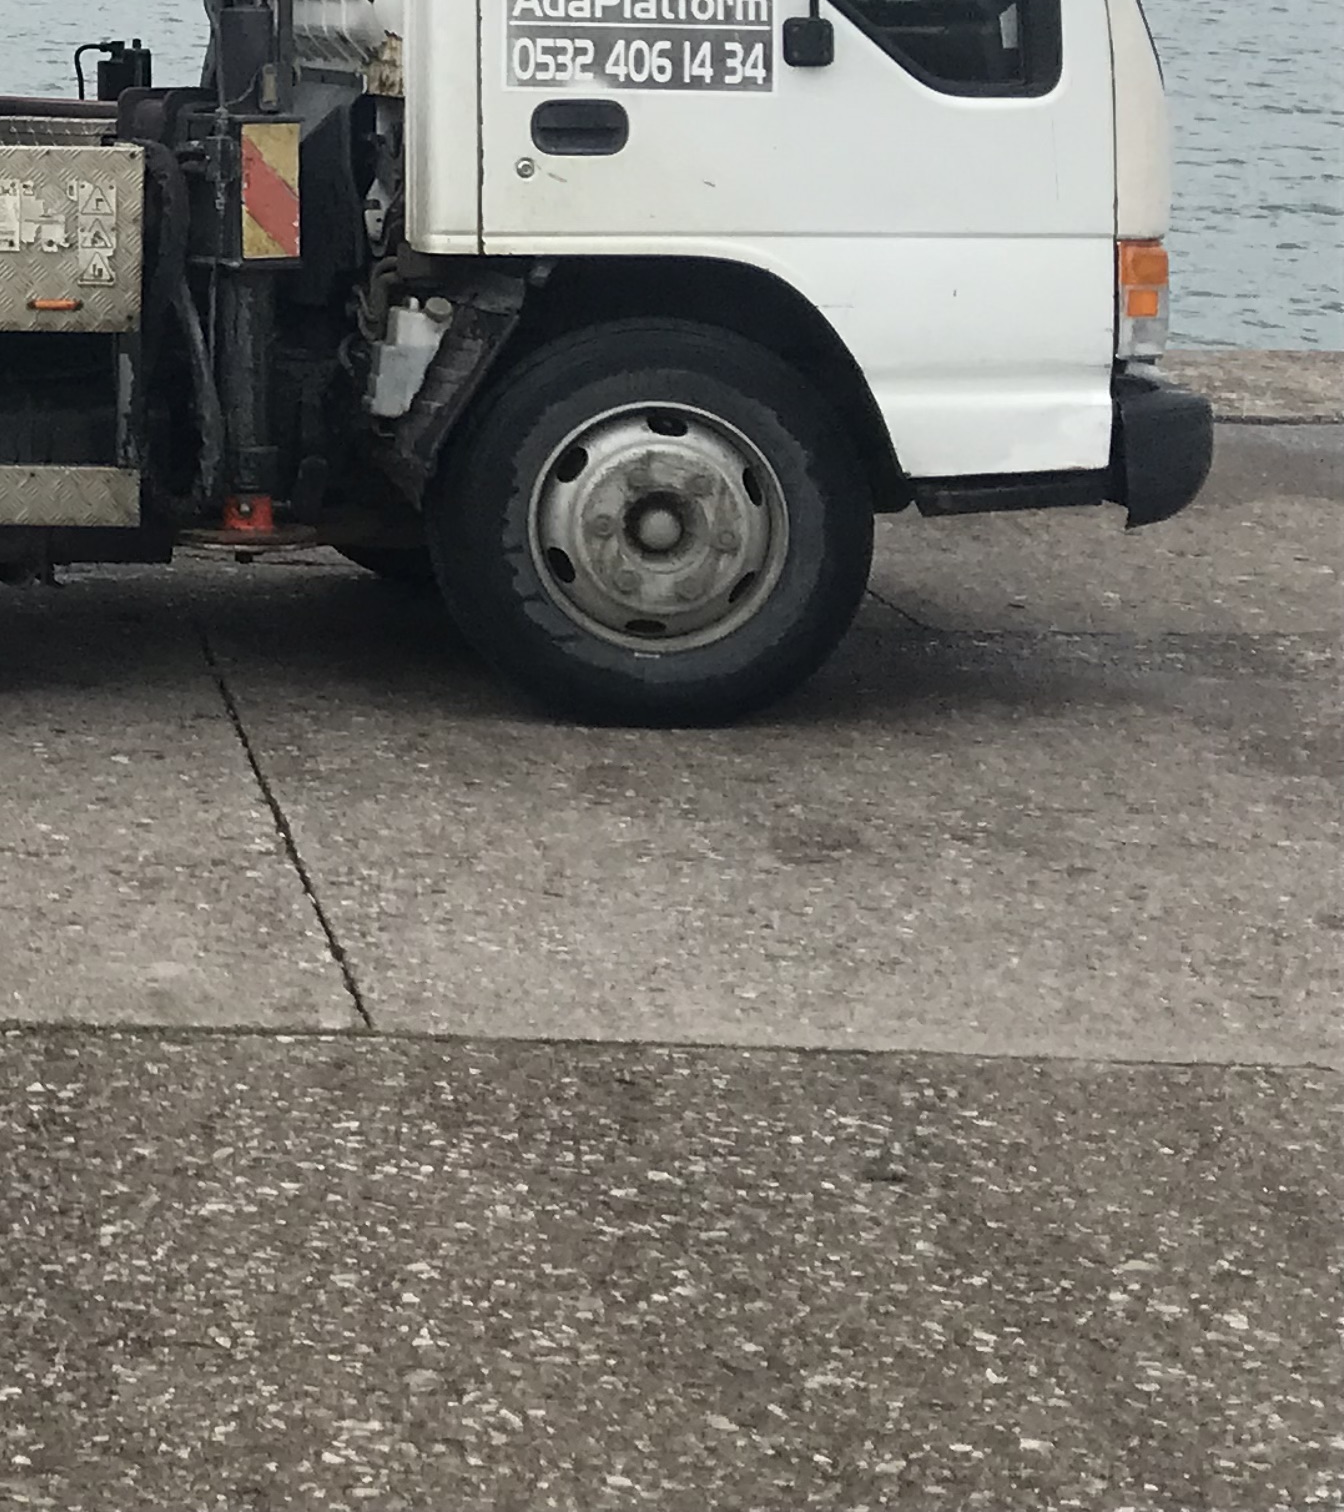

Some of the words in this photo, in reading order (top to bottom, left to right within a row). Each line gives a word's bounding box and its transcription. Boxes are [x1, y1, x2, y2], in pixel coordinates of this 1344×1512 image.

[512, 37, 595, 81] 0532
[605, 39, 673, 83] 406
[683, 40, 714, 84] 14
[724, 41, 767, 85] 34
